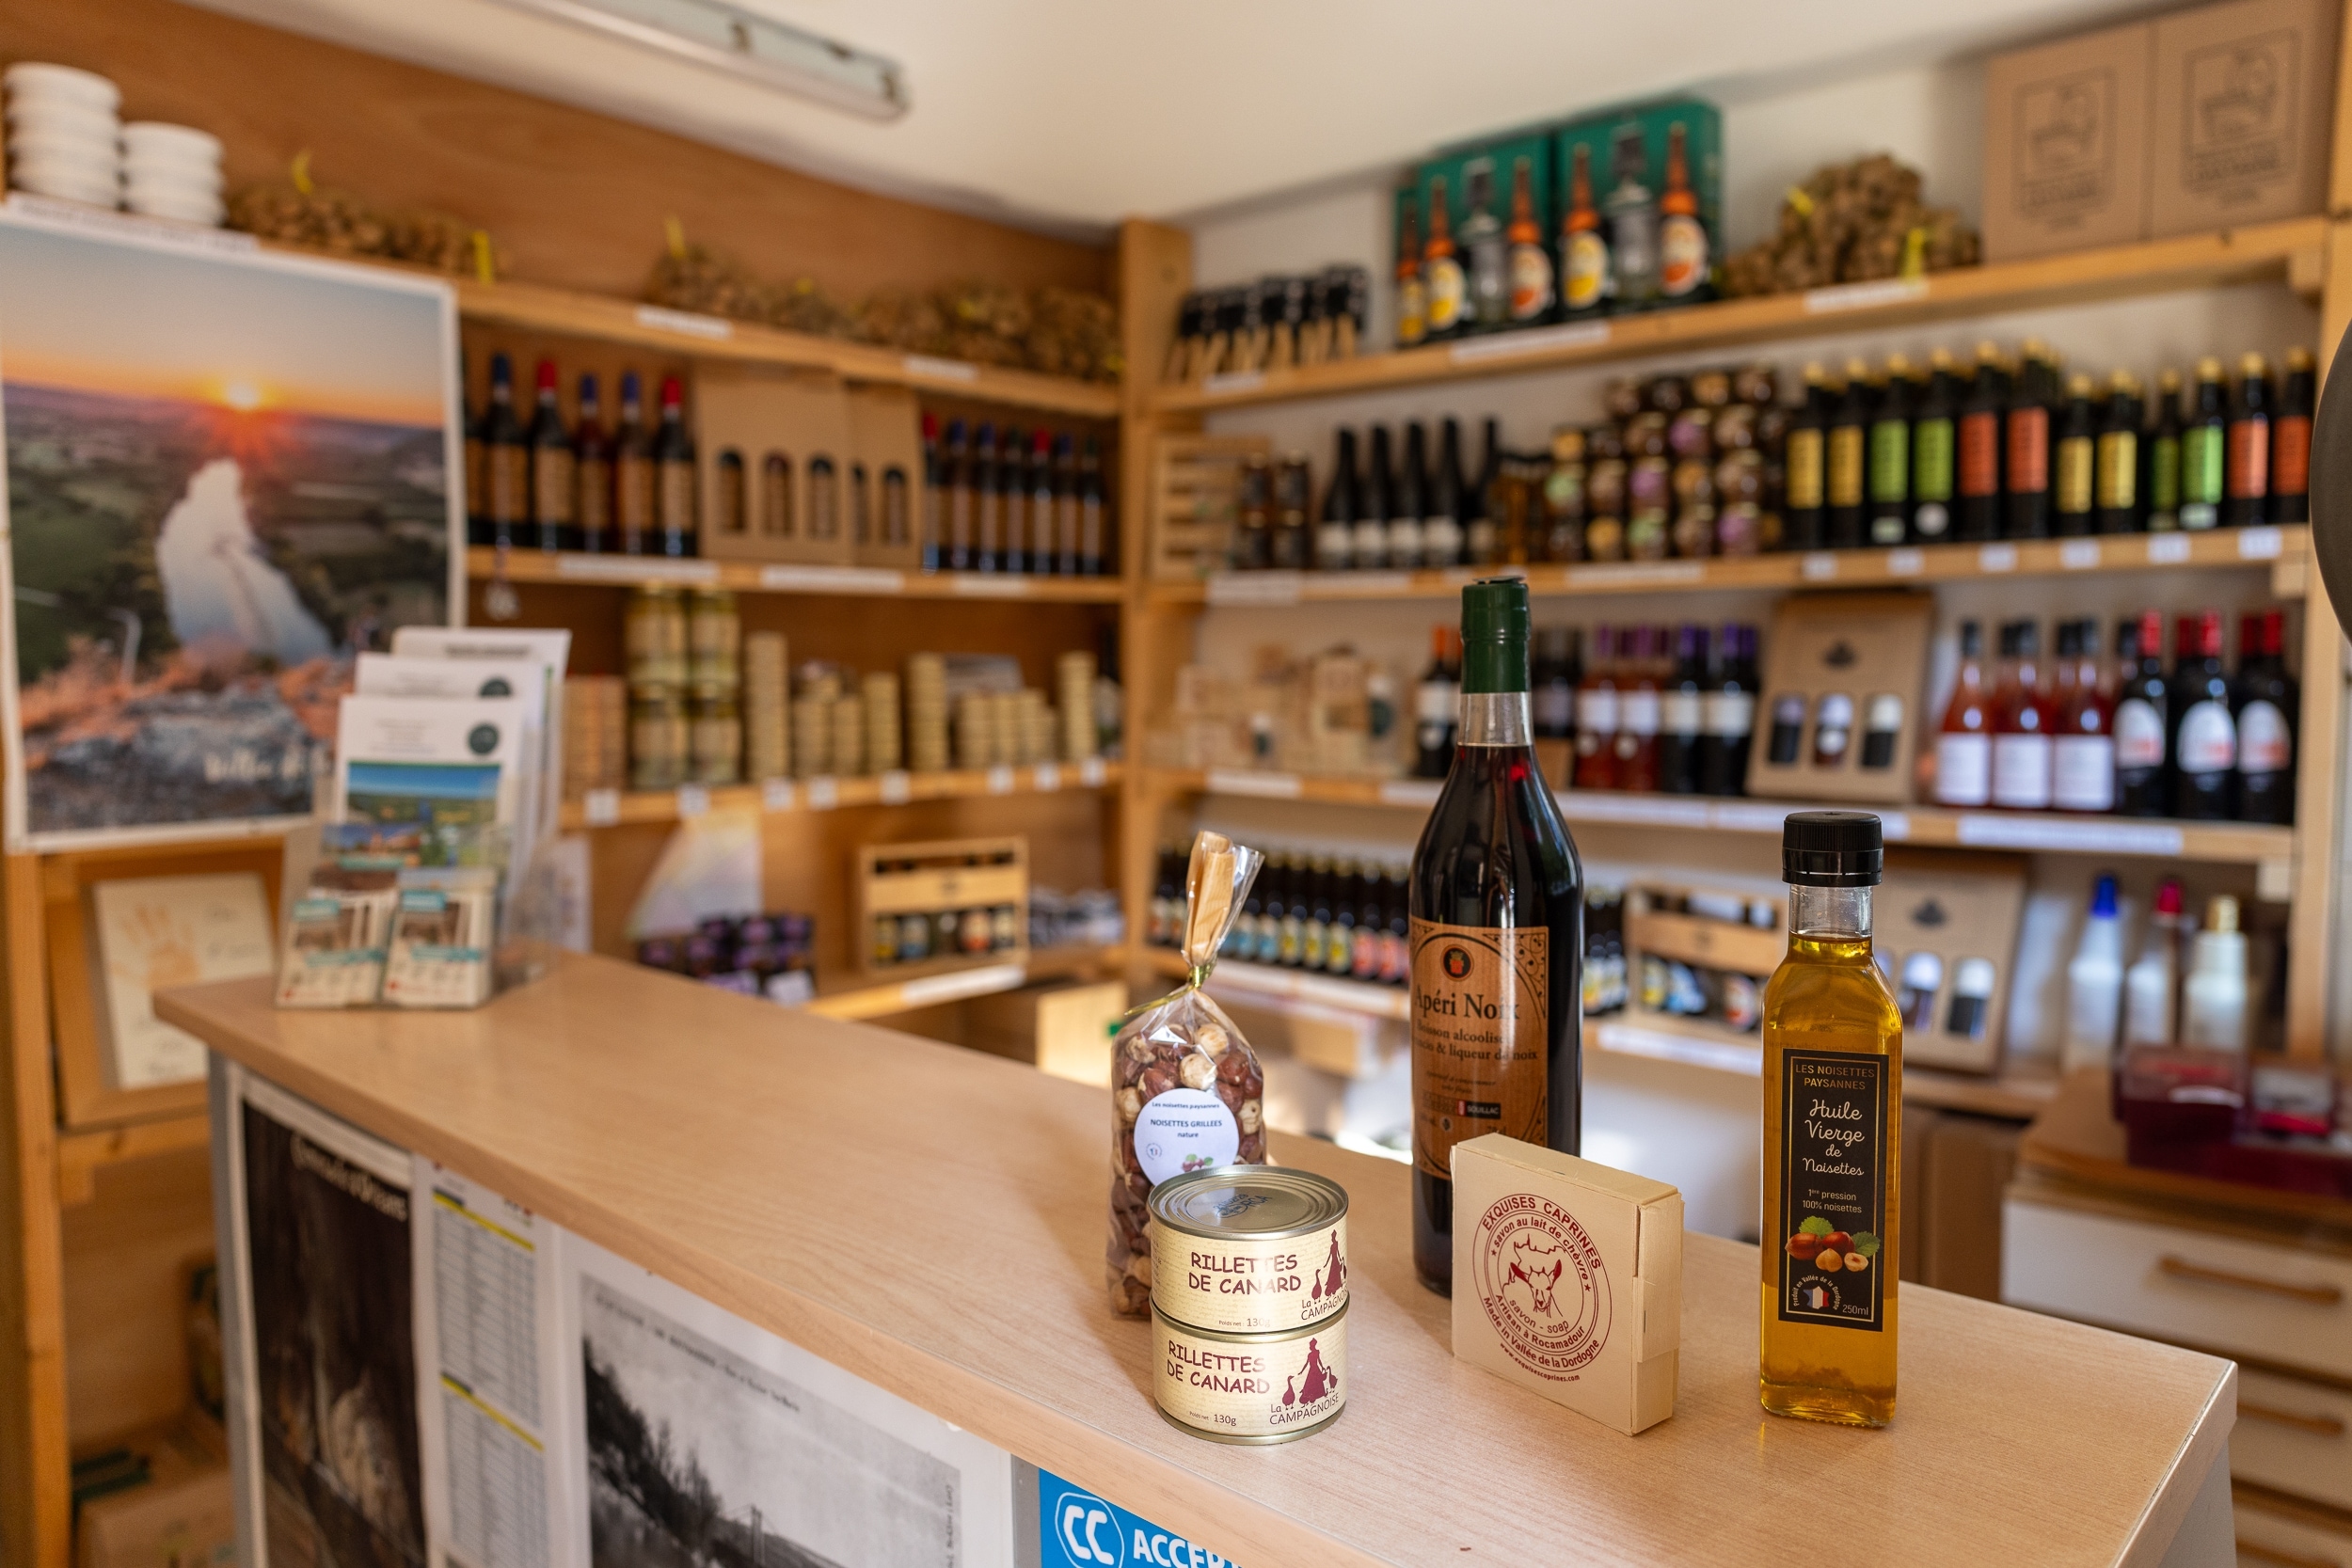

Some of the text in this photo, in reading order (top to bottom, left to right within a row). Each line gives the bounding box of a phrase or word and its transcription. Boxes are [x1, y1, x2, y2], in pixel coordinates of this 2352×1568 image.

[1414, 985, 1519, 1020] Apéri Noix
[1450, 1044, 1491, 1061] liqueur
[1494, 1048, 1508, 1061] de
[1513, 1049, 1537, 1060] noix
[1795, 1064, 1875, 1078] LES NOISETTES
[1804, 1077, 1866, 1090] PAYSANNES
[1809, 1099, 1863, 1120] Huile
[1151, 1118, 1222, 1128] NOISETTES GRILLEES
[1804, 1119, 1866, 1148] Vierge
[1825, 1143, 1842, 1157] de
[1802, 1157, 1865, 1176] Noisettes
[1802, 1199, 1863, 1213] 100% noisettes
[1821, 1191, 1857, 1201] pression
[1482, 1196, 1601, 1270] EXQUISES CAPRINES
[1493, 1216, 1588, 1281] savon au lait de chèvre
[1188, 1272, 1302, 1295] DE CANARD
[1791, 1287, 1800, 1307] Produit
[1801, 1275, 1819, 1283] Vallée
[1832, 1286, 1841, 1310] Dordogne
[1301, 1299, 1311, 1309] La
[1842, 1305, 1869, 1316] 250ml
[1496, 1294, 1585, 1350] Artisan à Rocamadour
[1510, 1299, 1536, 1328] savon
[1547, 1320, 1569, 1334] soap
[1484, 1297, 1599, 1369] Made in Vallée de la Dordogne
[1168, 1339, 1265, 1373] RILLETTES
[1167, 1358, 1270, 1395] DE CANARD
[1270, 1403, 1282, 1413] La
[1270, 1392, 1340, 1425] CAMPAGNOISE
[1214, 1414, 1237, 1427] 130g
[1133, 1528, 1243, 1568] ACCEP
